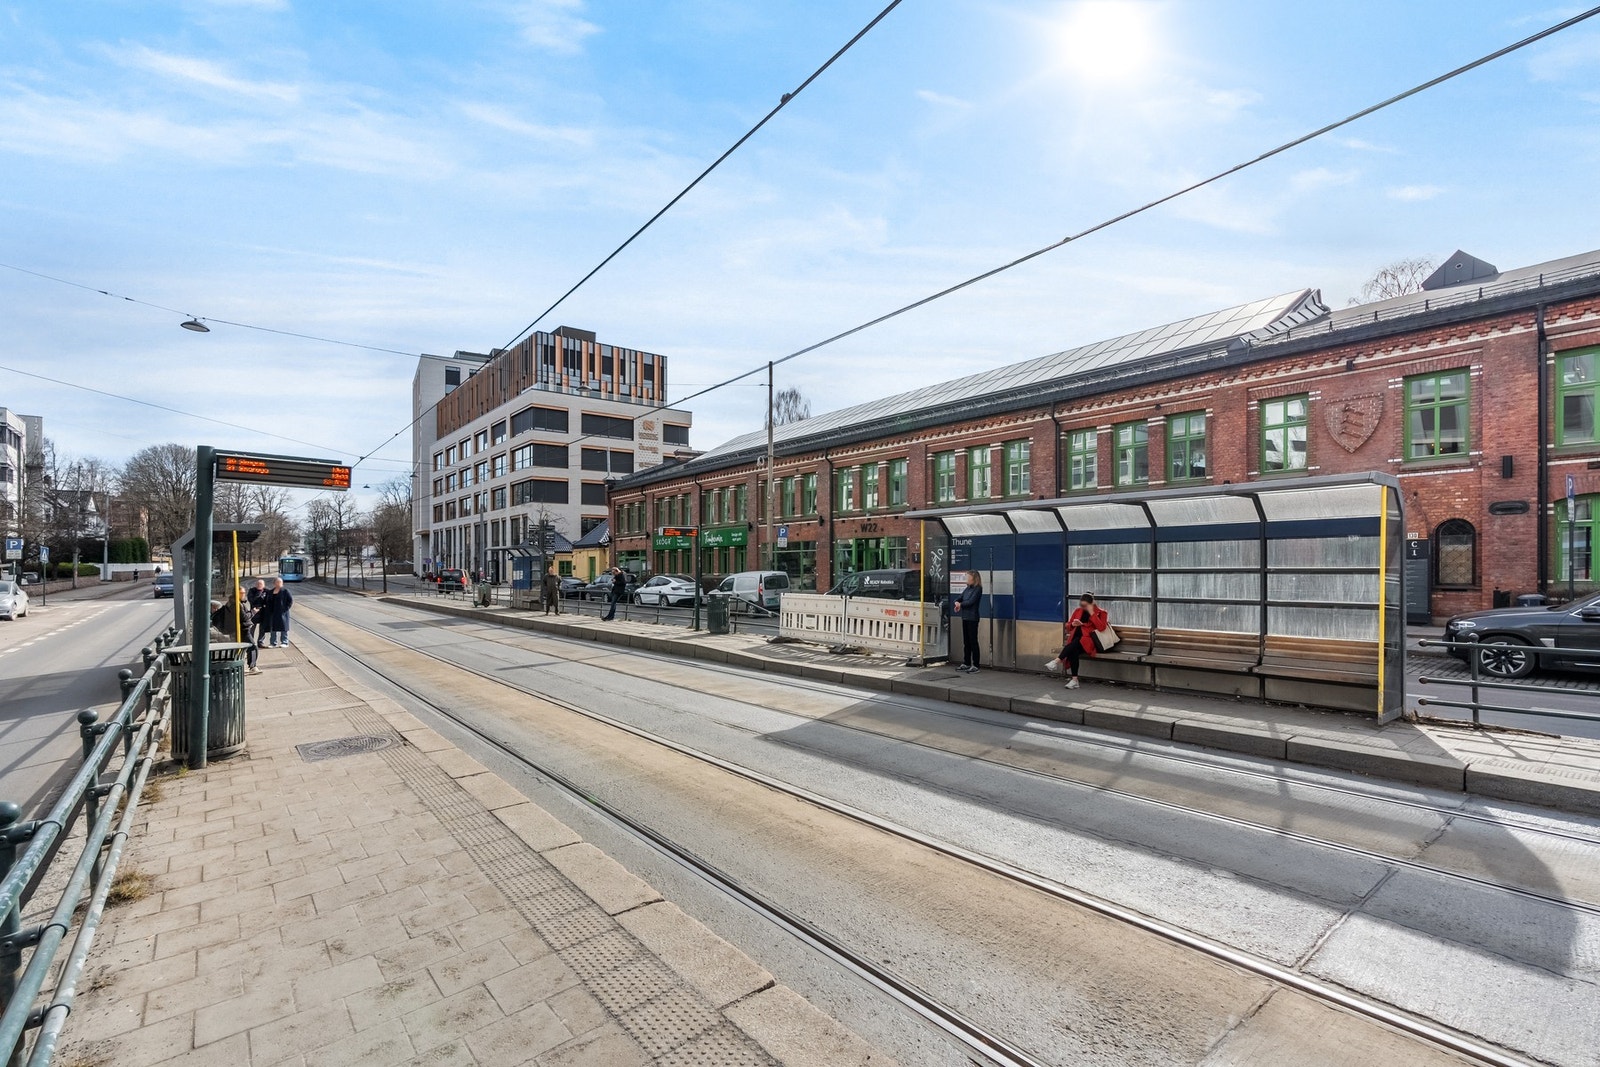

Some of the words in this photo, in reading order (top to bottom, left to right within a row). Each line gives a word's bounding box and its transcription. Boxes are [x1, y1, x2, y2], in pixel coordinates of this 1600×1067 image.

[1568, 478, 1573, 496] P
[861, 523, 877, 532] W22
[780, 528, 786, 536] P
[10, 541, 18, 549] P
